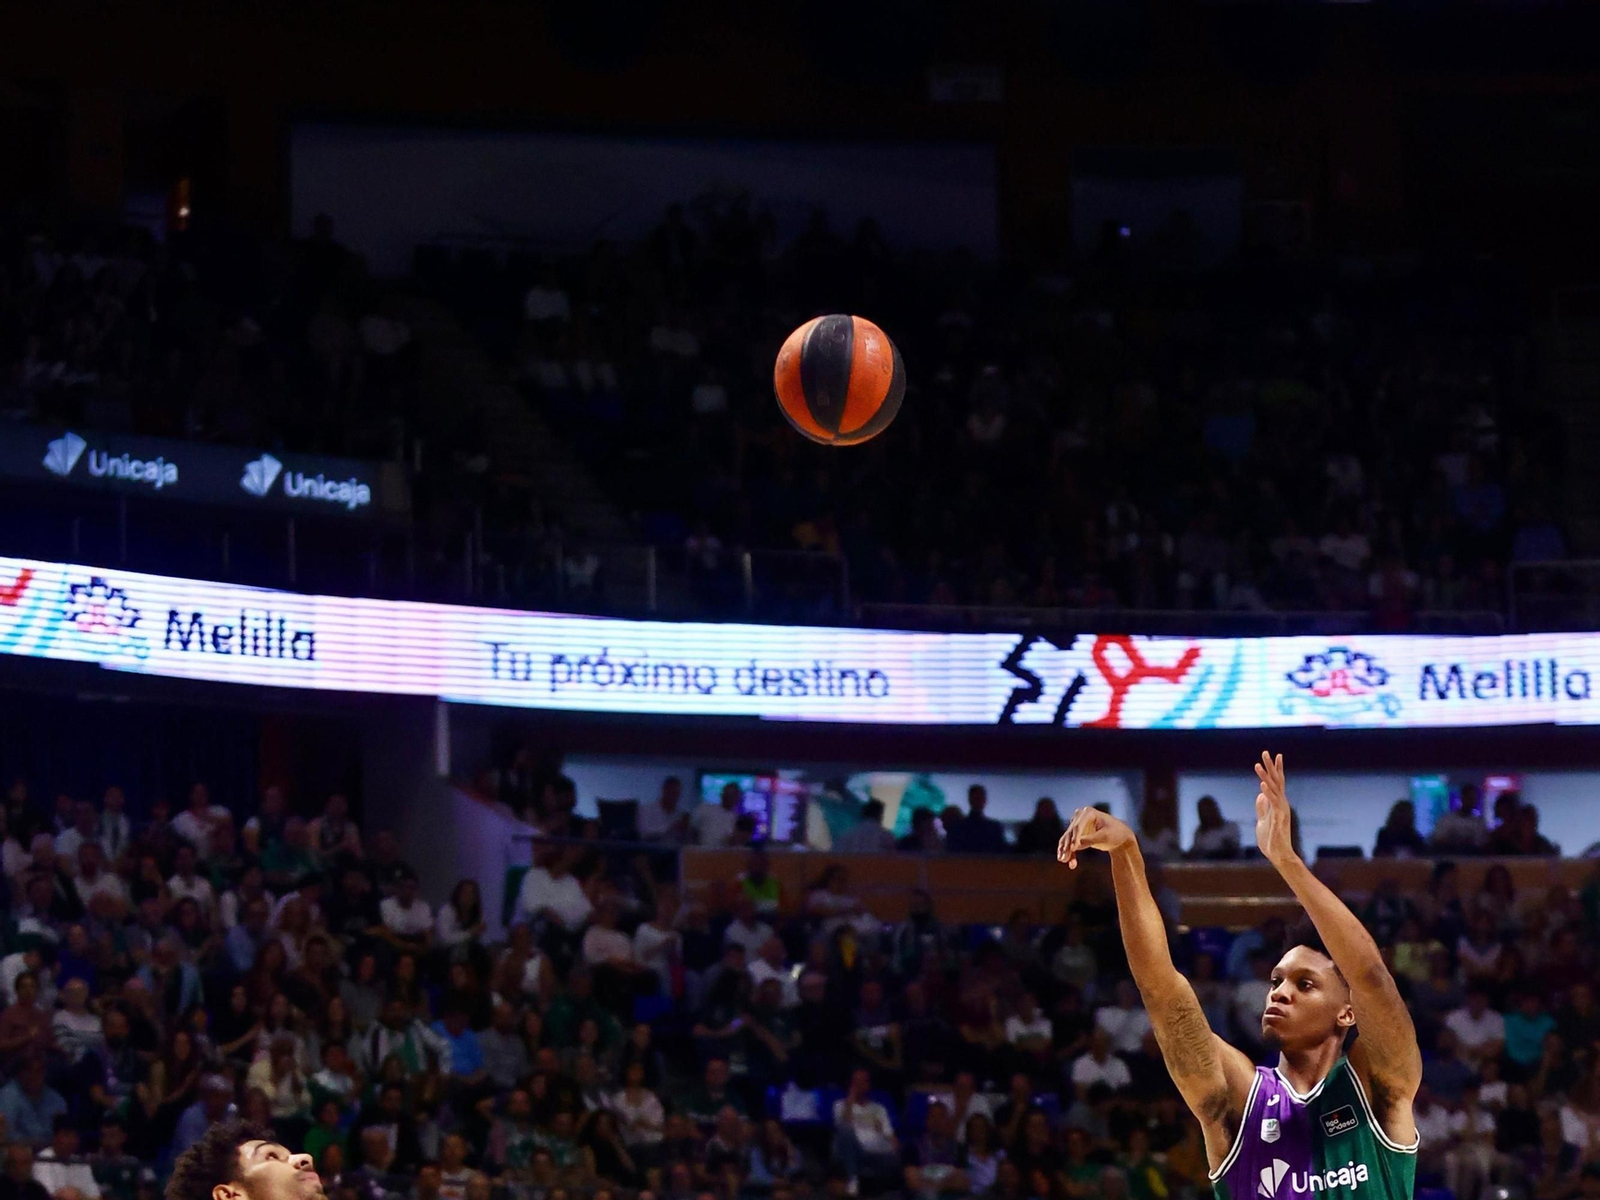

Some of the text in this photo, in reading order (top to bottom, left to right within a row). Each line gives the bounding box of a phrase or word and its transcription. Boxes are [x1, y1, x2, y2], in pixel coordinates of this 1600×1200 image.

[88, 448, 179, 489] Unicaja
[283, 471, 371, 510] Unicaja
[164, 607, 315, 661] Melilla
[483, 641, 891, 699] Tu próximo destino
[1419, 658, 1591, 702] Melilla
[1291, 1160, 1369, 1193] Unicaja
